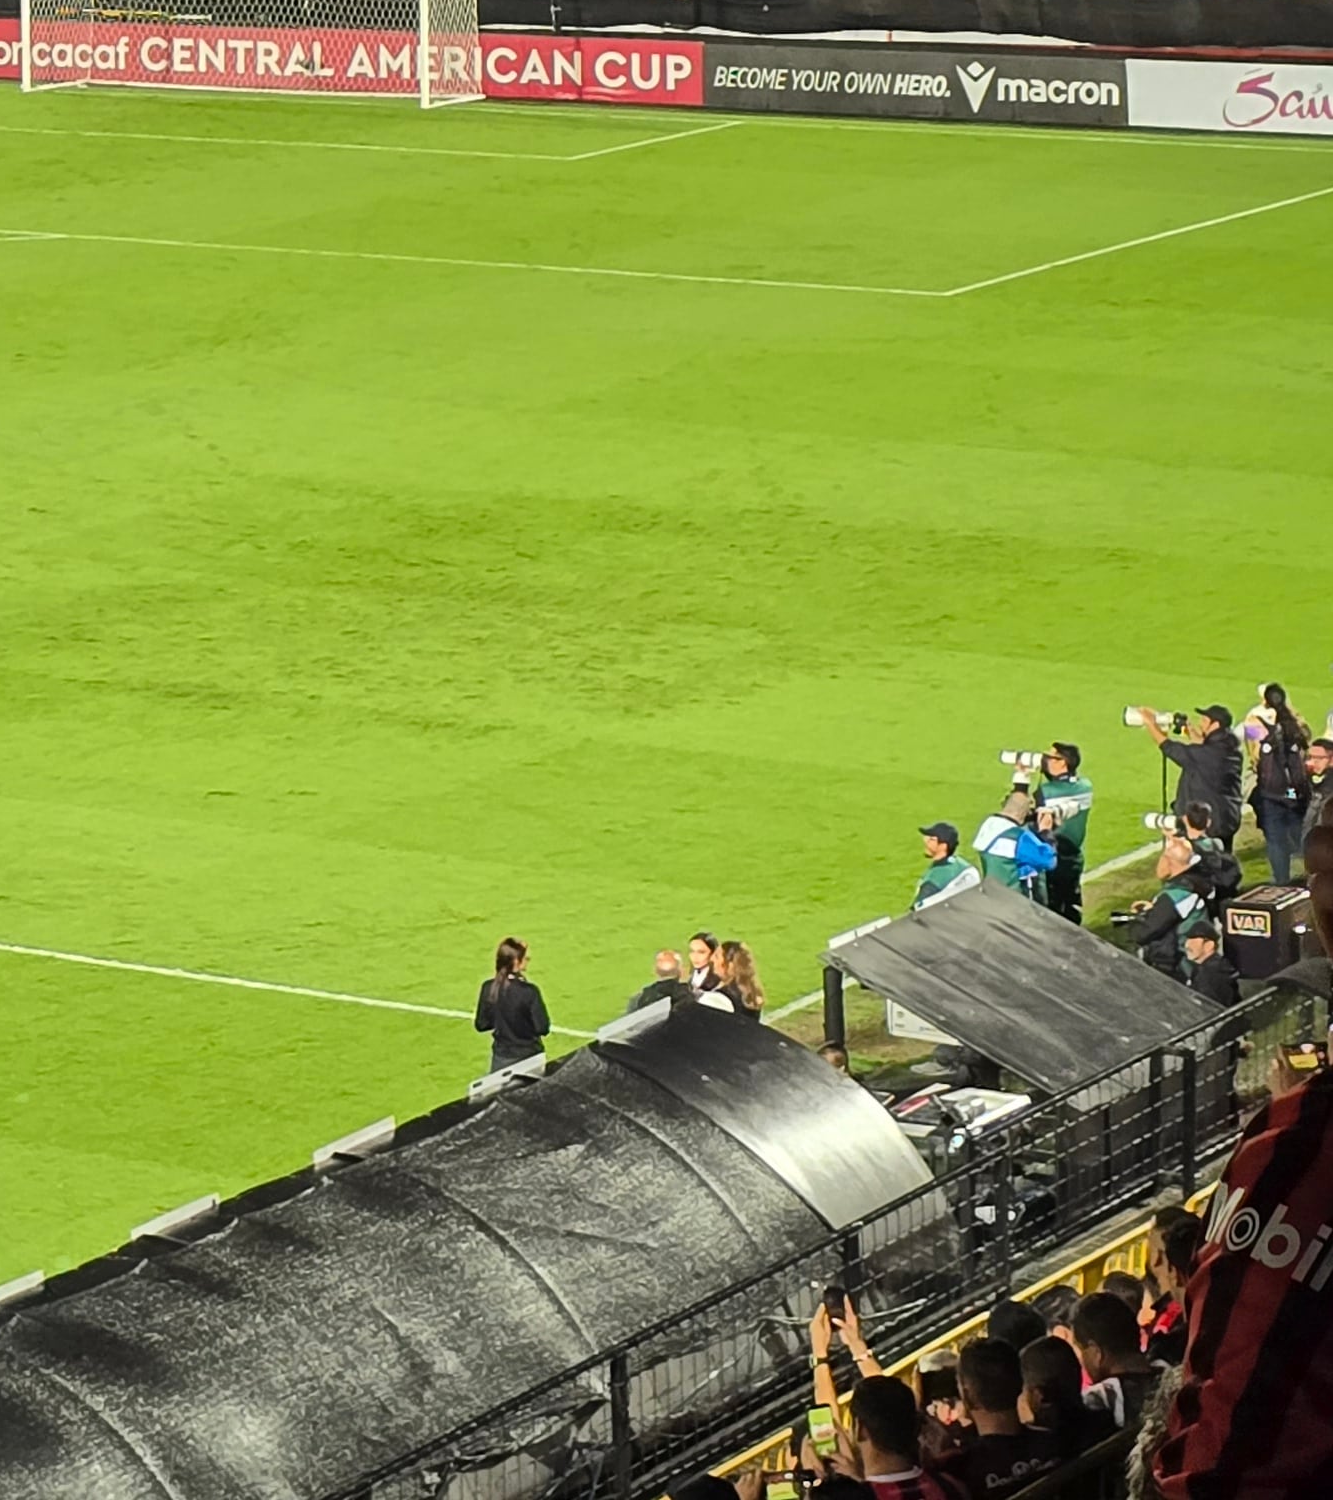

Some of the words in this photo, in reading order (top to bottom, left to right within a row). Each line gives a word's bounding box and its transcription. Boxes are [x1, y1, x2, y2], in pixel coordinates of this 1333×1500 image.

[140, 36, 334, 77] CENTRAL
[594, 51, 692, 91] CUP
[713, 66, 788, 90] BECOME
[791, 69, 841, 92] YOUR
[844, 71, 891, 95] OWN
[893, 74, 951, 97] HERO.
[997, 78, 1121, 106] macron
[1233, 914, 1266, 931] VAR
